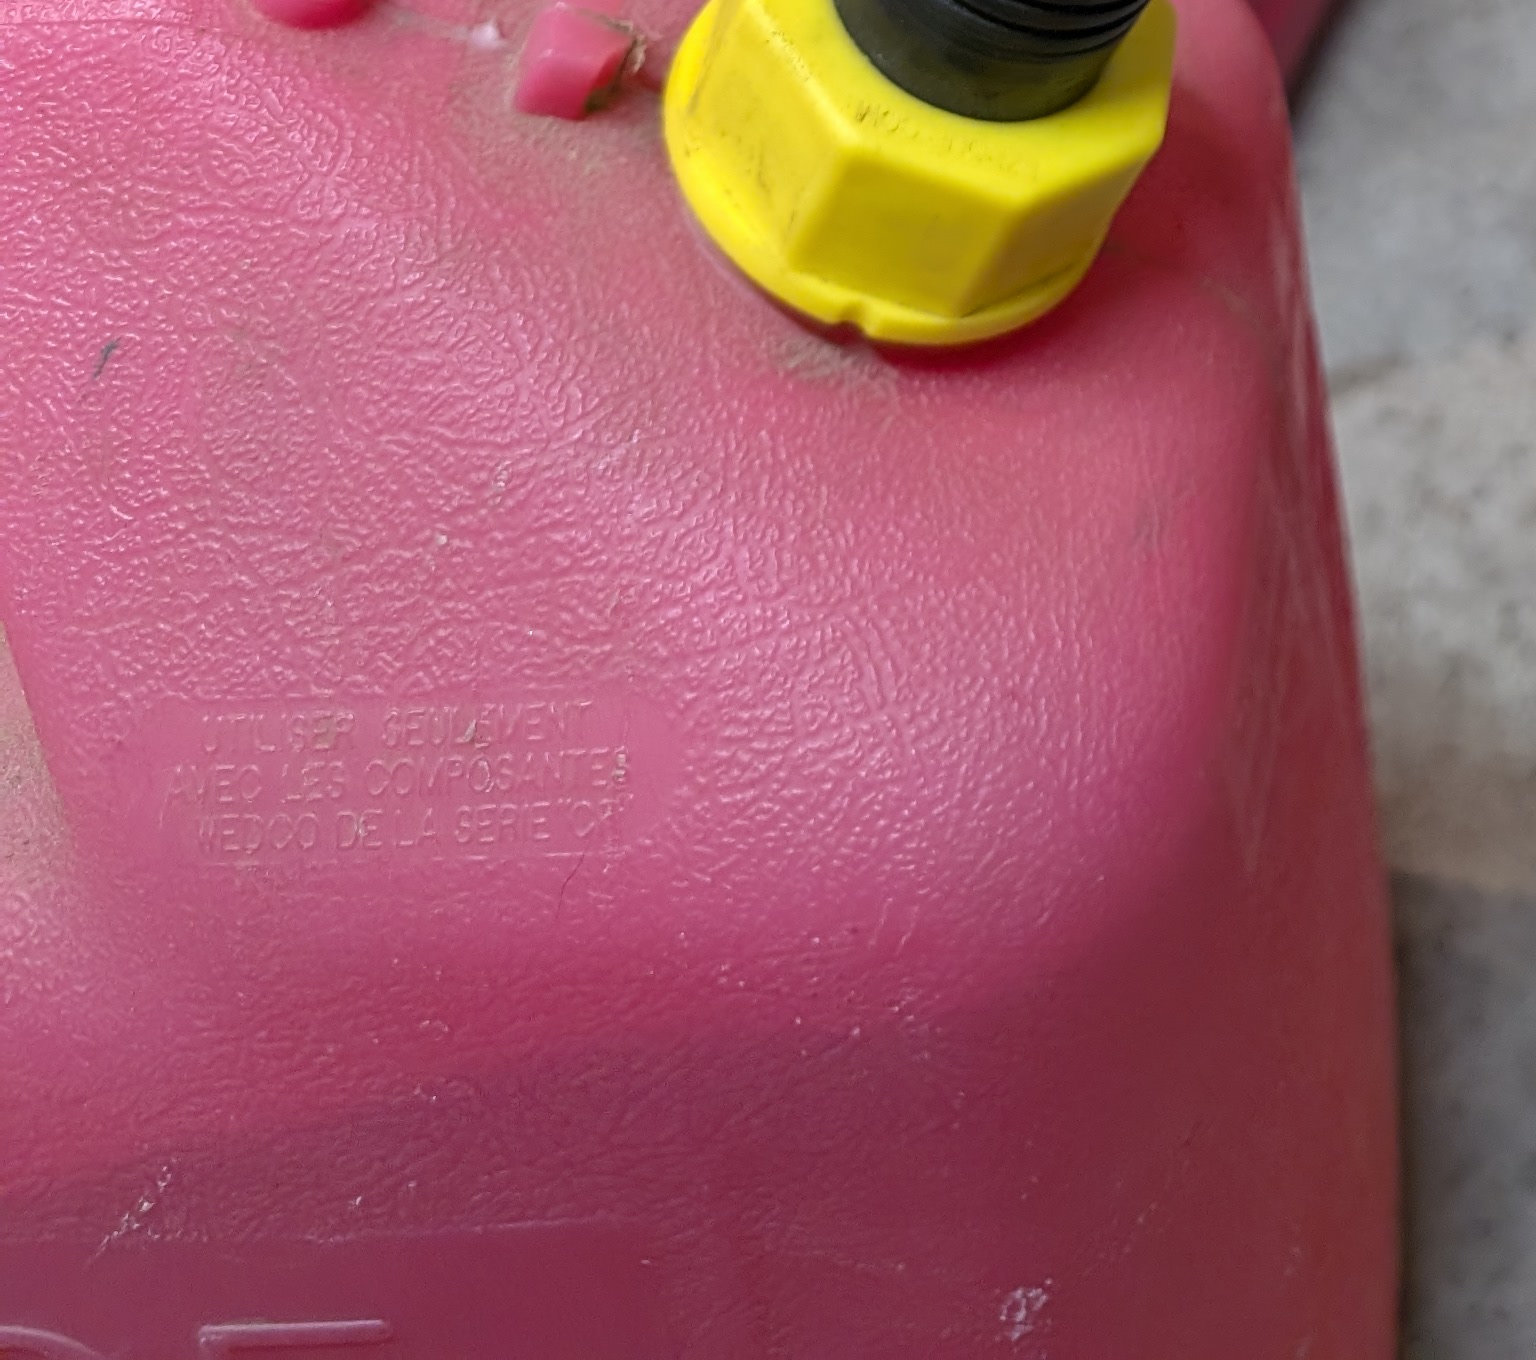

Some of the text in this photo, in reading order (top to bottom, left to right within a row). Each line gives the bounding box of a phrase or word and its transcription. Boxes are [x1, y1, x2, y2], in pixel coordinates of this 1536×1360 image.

[201, 700, 595, 755] UTILISER SEULEMENT
[164, 763, 264, 806] AVEC
[279, 757, 346, 805] LES
[196, 810, 320, 856] WEDCO
[336, 807, 384, 852] DE
[392, 805, 437, 850] LA
[454, 800, 551, 846] SERIE
